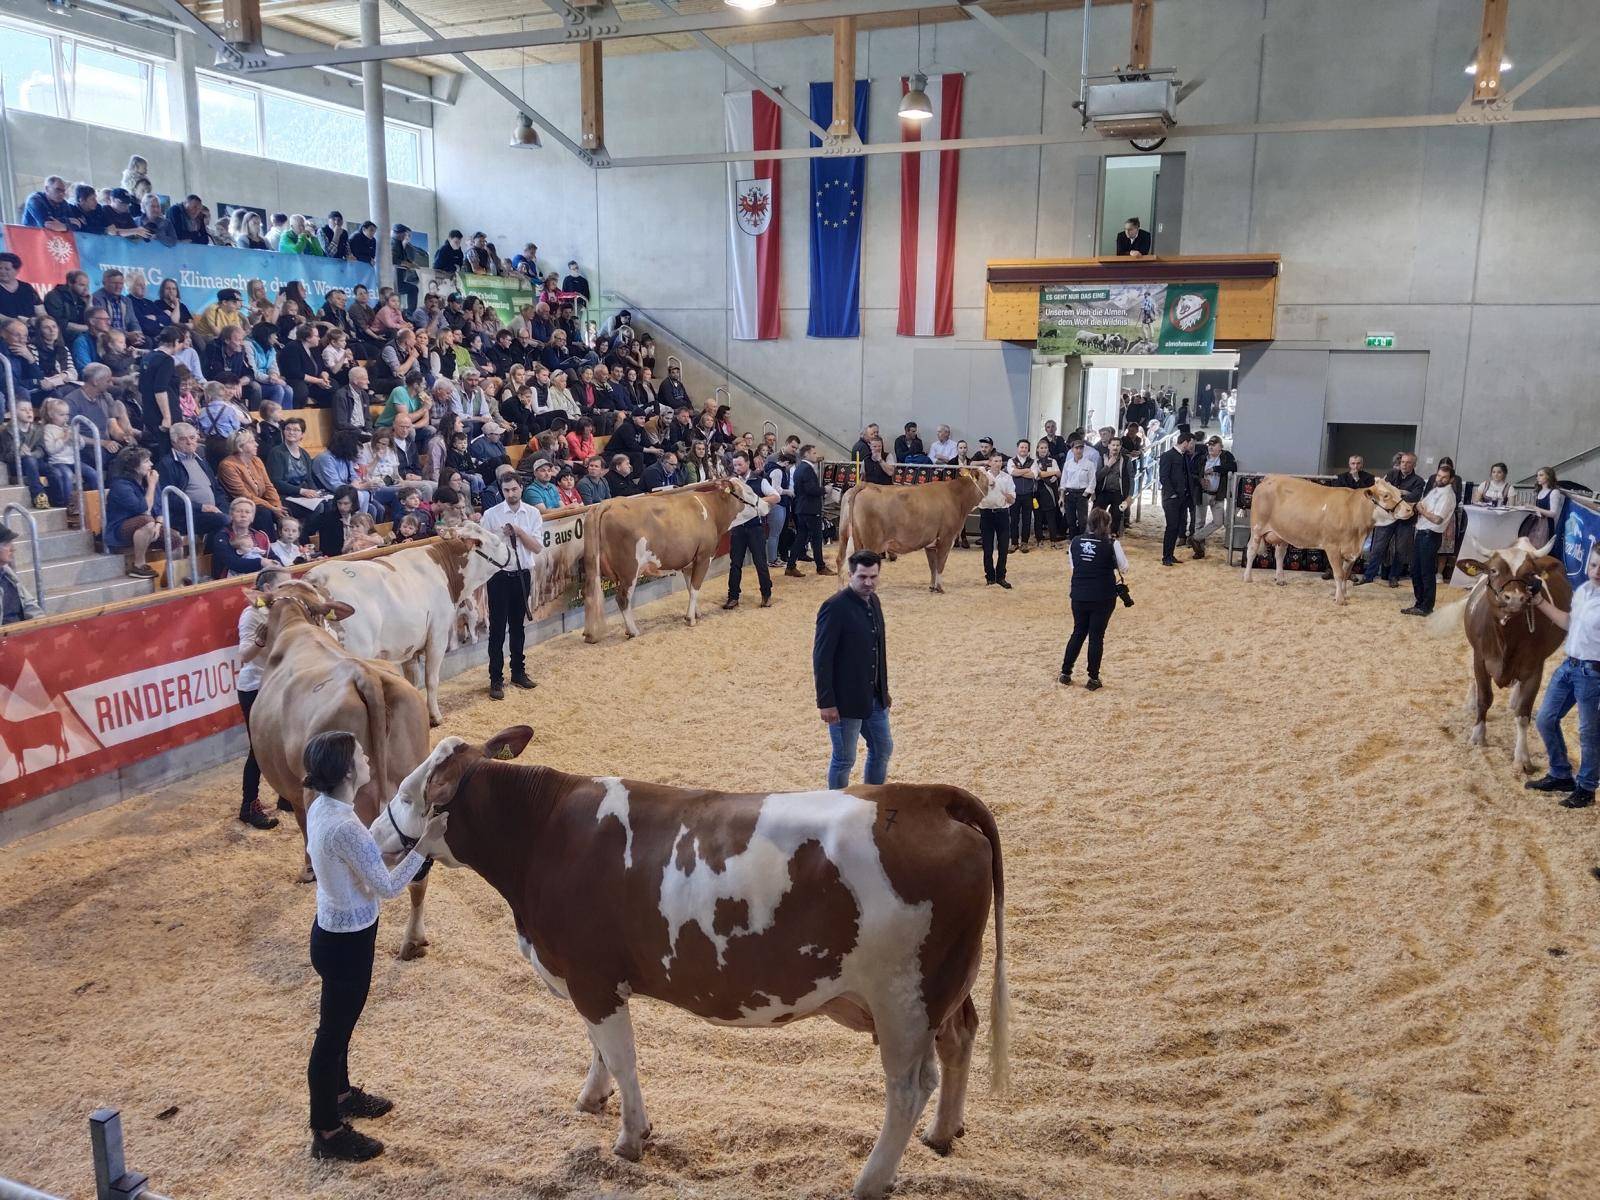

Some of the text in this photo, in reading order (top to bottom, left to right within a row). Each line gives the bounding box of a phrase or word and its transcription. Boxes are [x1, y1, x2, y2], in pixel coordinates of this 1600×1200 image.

[180, 270, 267, 292] Klimaschz
[1045, 308, 1128, 317] Unserem Vieh die Almen,
[1058, 318, 1130, 326] dem Wolf die Wildnis!
[555, 529, 572, 545] aus
[884, 808, 898, 832] 7
